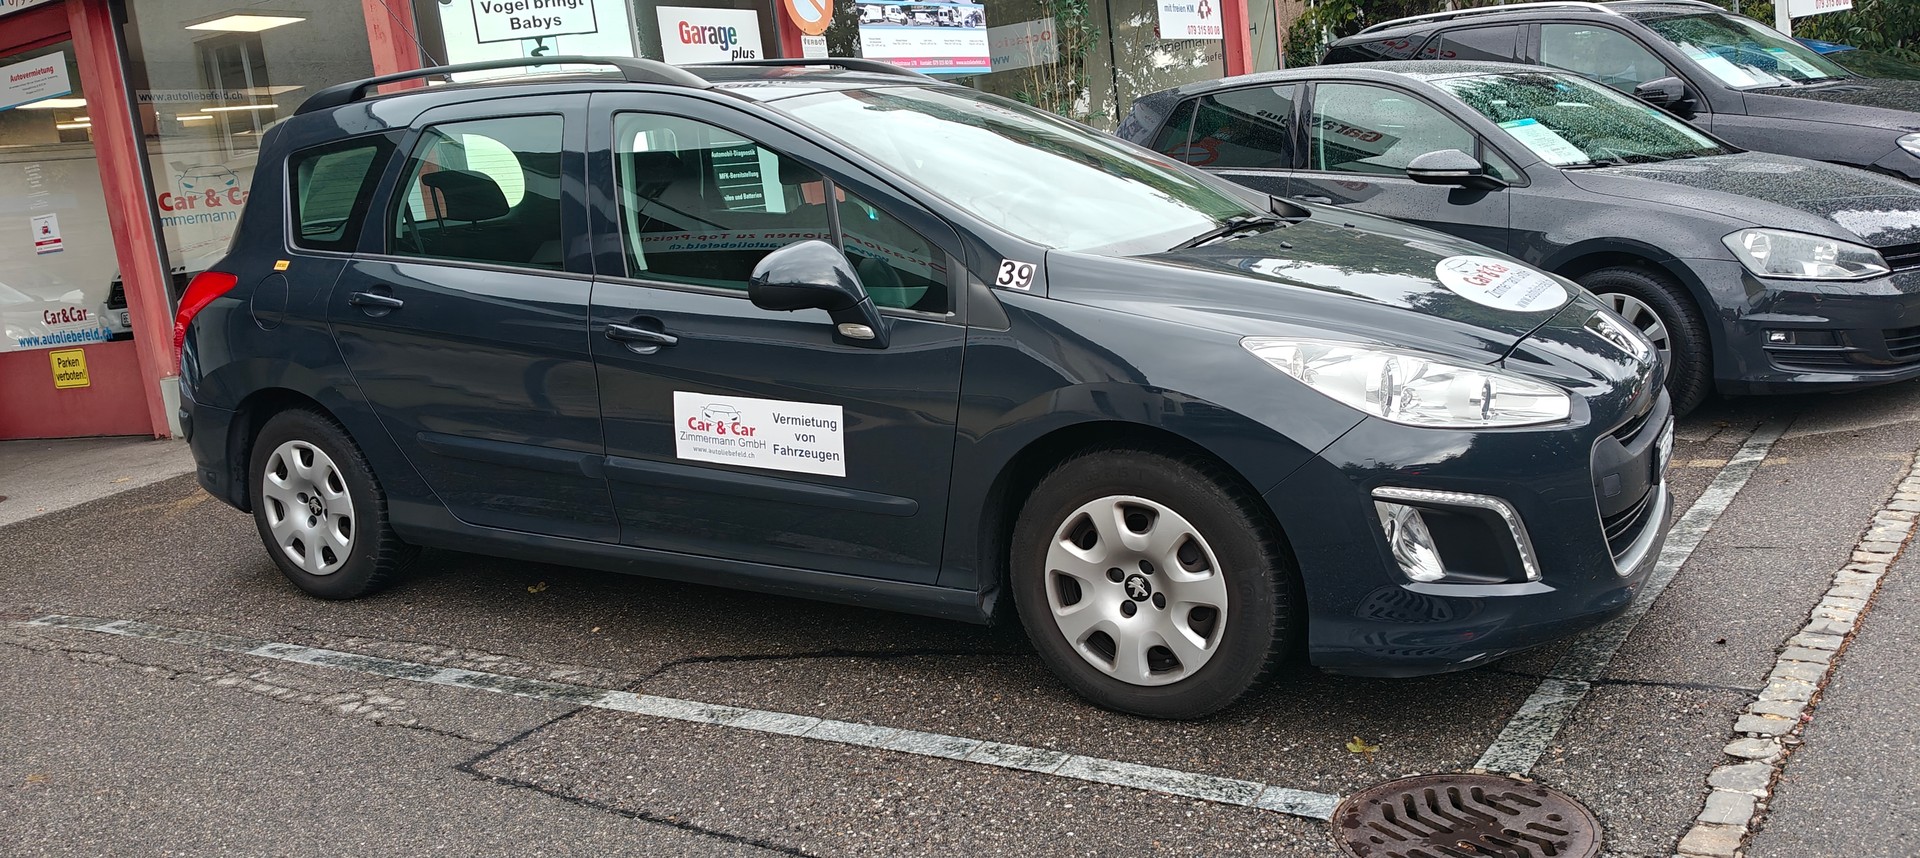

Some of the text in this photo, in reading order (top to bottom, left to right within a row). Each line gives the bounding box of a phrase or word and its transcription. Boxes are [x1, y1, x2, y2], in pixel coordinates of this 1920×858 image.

[480, 0, 529, 14] Vogel
[510, 15, 562, 30] Babys
[678, 20, 738, 51] Garage
[732, 46, 756, 61] plus
[10, 66, 54, 82] Autovermietung
[138, 90, 243, 102] www.autoliebefeld.ch
[158, 186, 249, 211] Car & Ca
[161, 210, 237, 227] mmermann
[998, 261, 1033, 288] 39
[43, 306, 88, 325] Car&Car
[18, 326, 113, 347] www.autoliebefeld.ch
[57, 358, 80, 368] Parken
[56, 369, 87, 382] verboten!
[687, 416, 756, 437] Car & Car
[772, 412, 837, 432] Vermietung
[680, 431, 767, 450] Zimmermann GmbH
[794, 432, 816, 443] von
[693, 446, 755, 459] www.autoliebefeld.ch
[773, 444, 840, 462] Fahrzeugen
